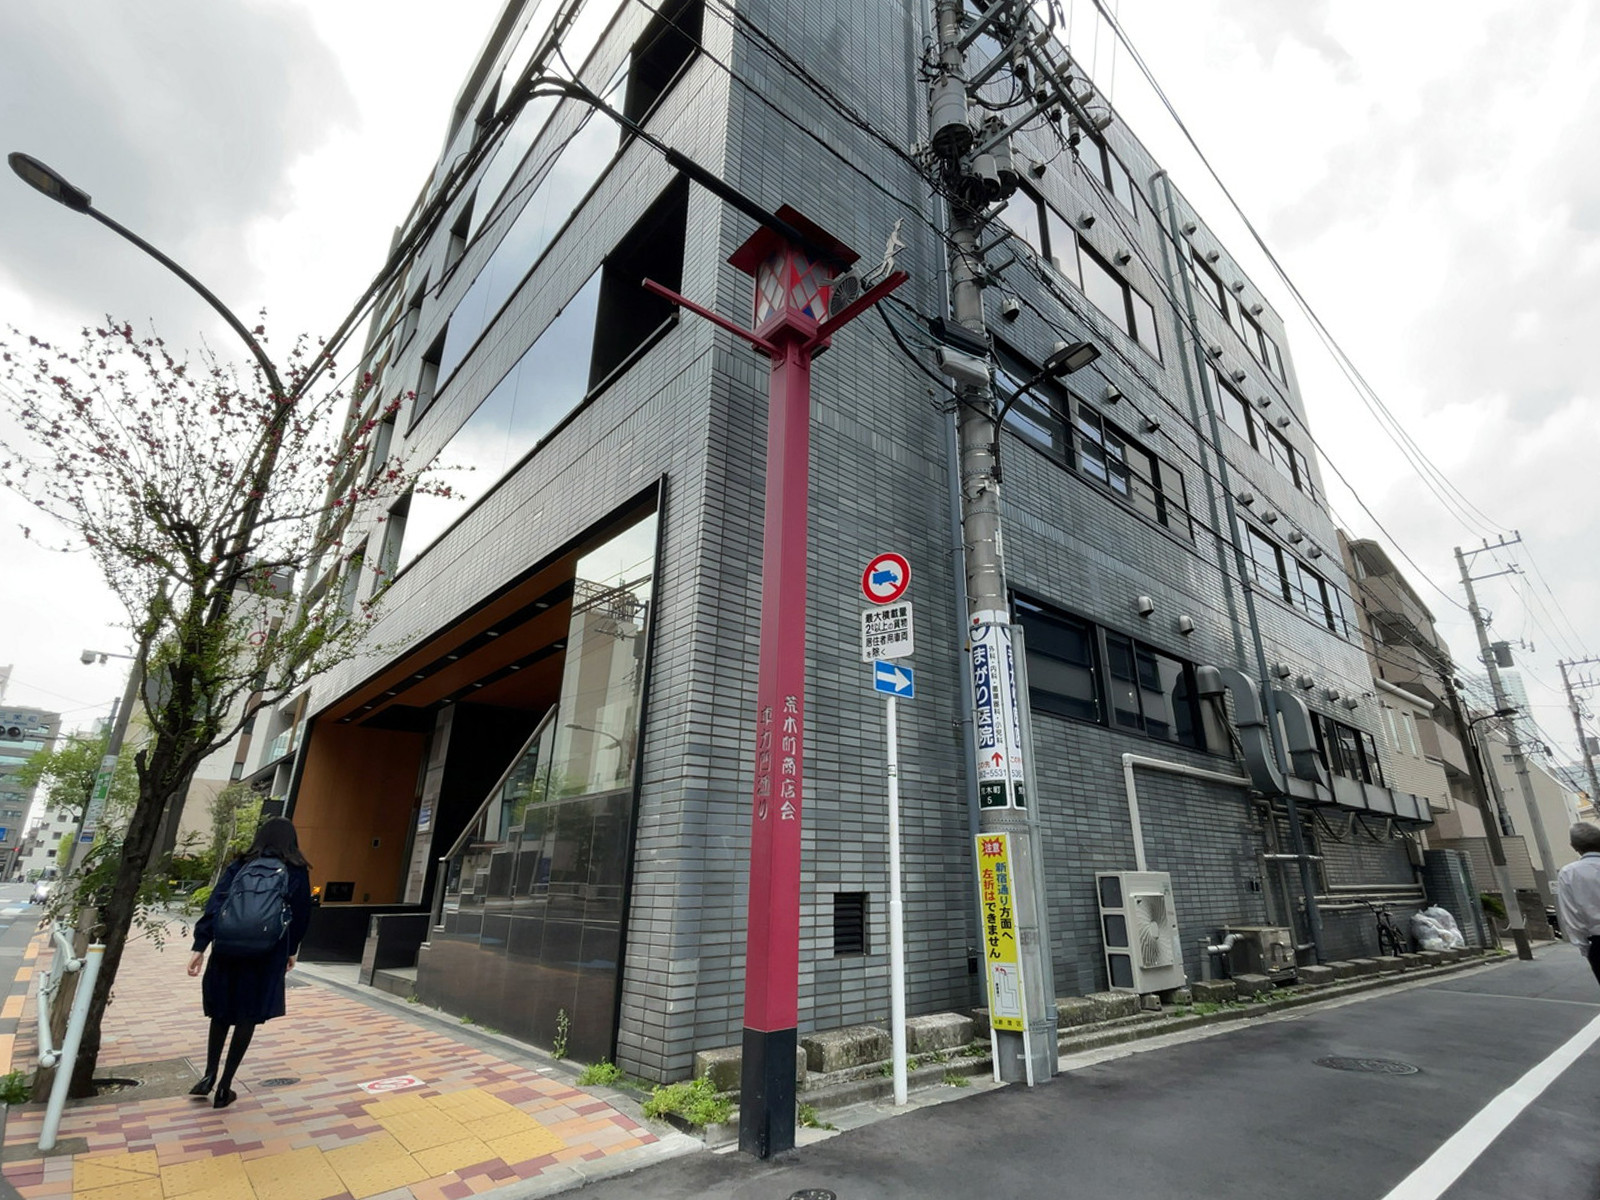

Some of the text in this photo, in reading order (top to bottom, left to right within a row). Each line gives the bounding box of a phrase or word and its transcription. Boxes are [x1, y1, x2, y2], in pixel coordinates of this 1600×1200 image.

[865, 607, 907, 623] 最大積載量
[866, 647, 886, 659] を除く
[973, 647, 994, 747] まがり医院
[757, 705, 773, 821] 車力門通り
[780, 695, 799, 821] 荒木町商店会
[985, 842, 1000, 853] 注意
[982, 868, 1001, 959] 左折はできません
[995, 861, 1013, 940] 新宿通り方面へ
